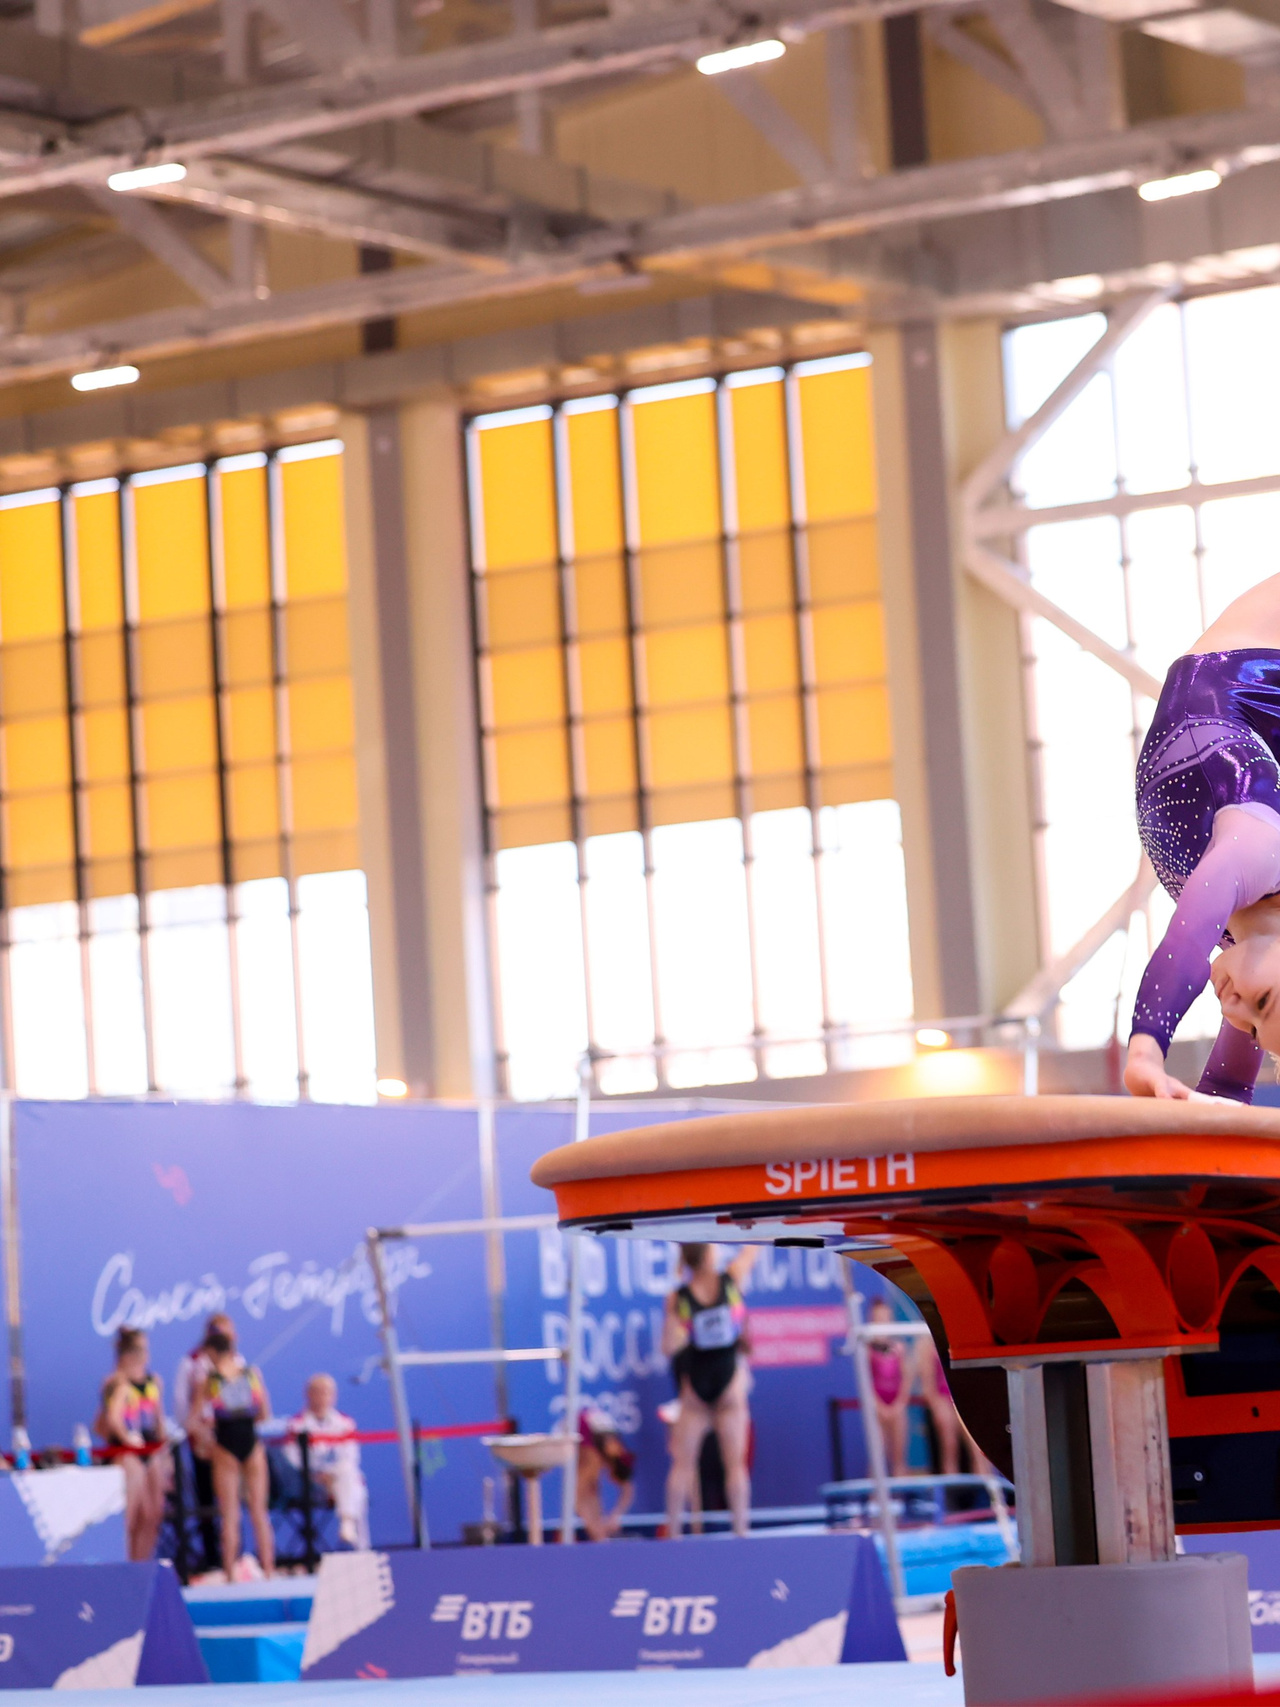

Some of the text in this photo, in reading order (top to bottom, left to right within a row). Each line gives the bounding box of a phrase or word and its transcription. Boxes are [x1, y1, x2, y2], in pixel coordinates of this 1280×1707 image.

[765, 1153, 915, 1195] SPIETH
[461, 1600, 534, 1640] ВТБ
[643, 1595, 718, 1636] ВТБ
